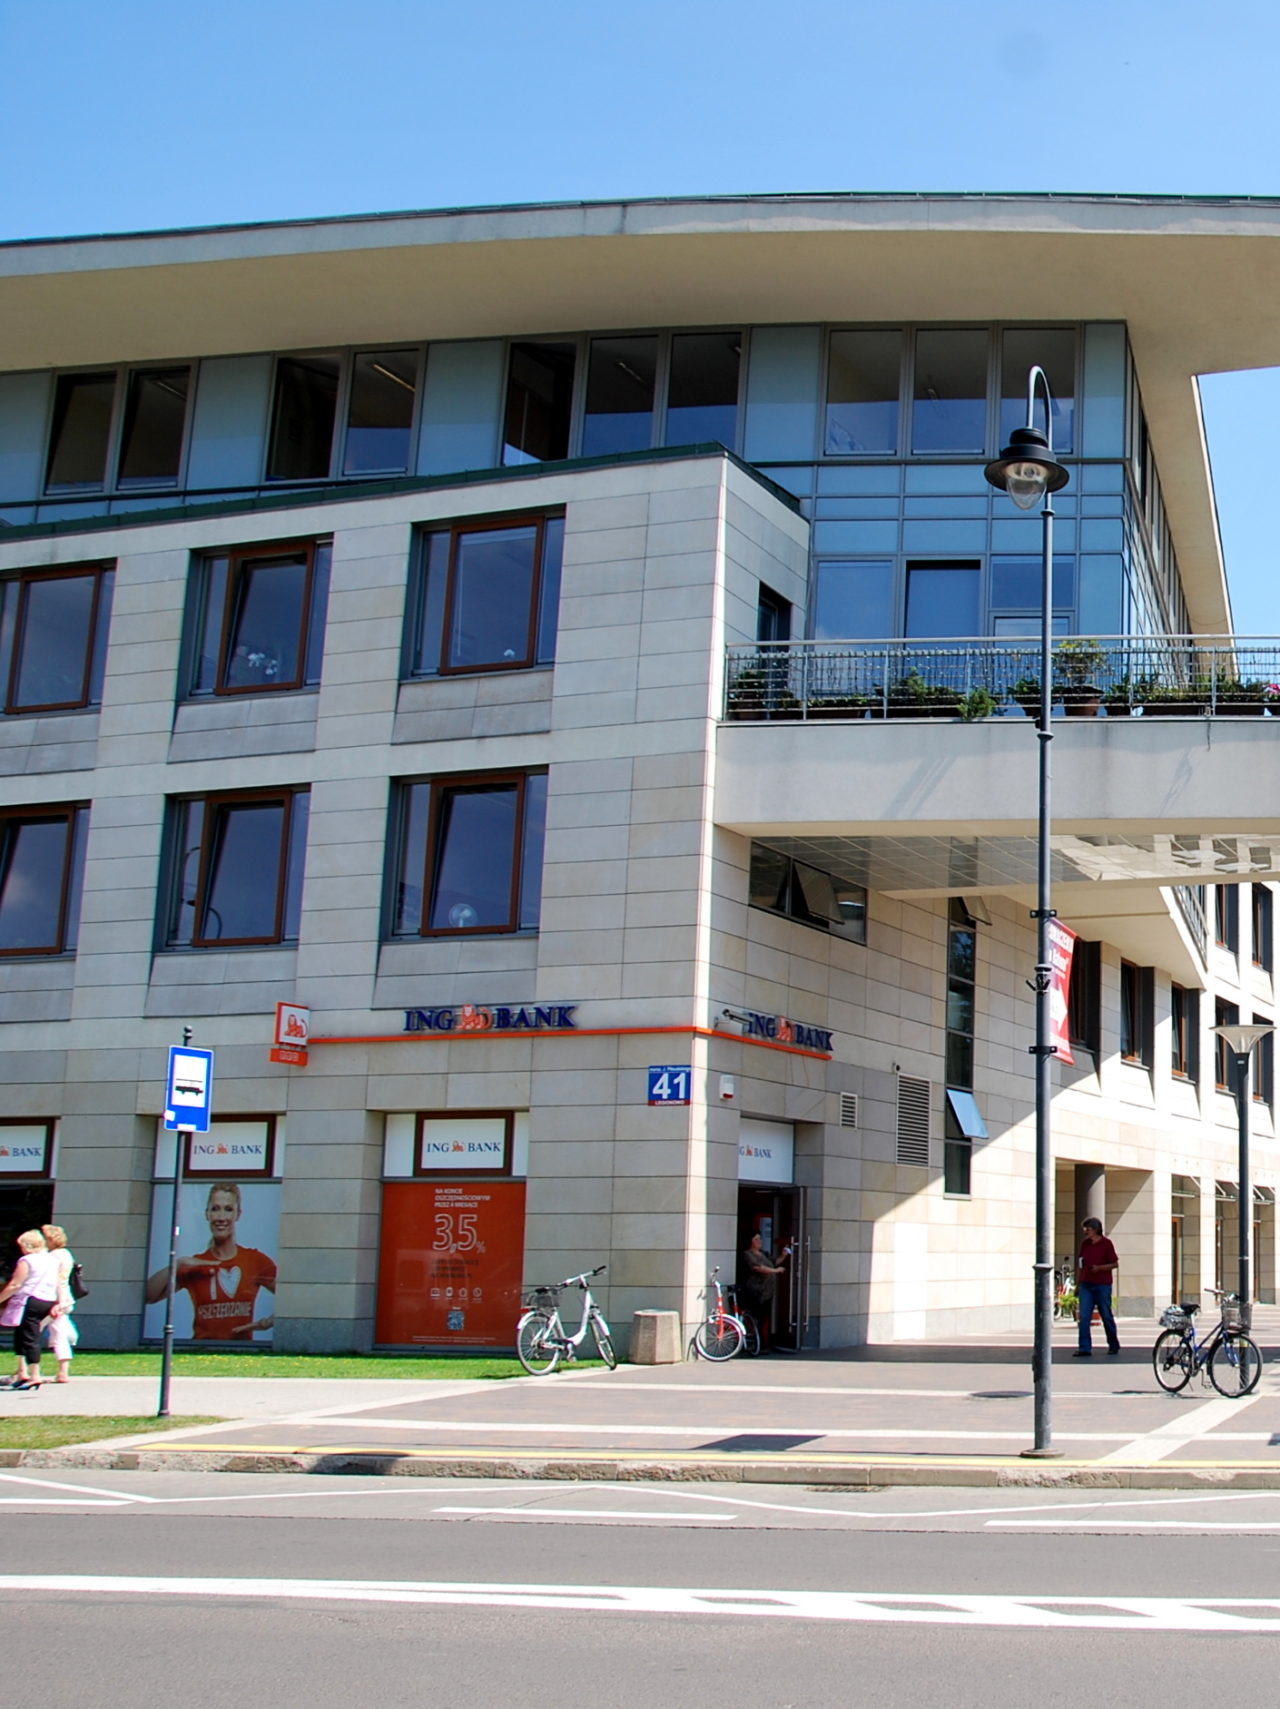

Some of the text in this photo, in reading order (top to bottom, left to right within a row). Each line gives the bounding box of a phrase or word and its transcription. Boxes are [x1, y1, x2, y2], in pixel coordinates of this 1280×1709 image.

[403, 1005, 577, 1031] ING BANK
[746, 1012, 833, 1051] ING BANK
[652, 1072, 686, 1099] 41
[12, 1147, 42, 1157] BANK
[193, 1144, 263, 1155] ING BANK
[426, 1141, 502, 1153] ING BANK
